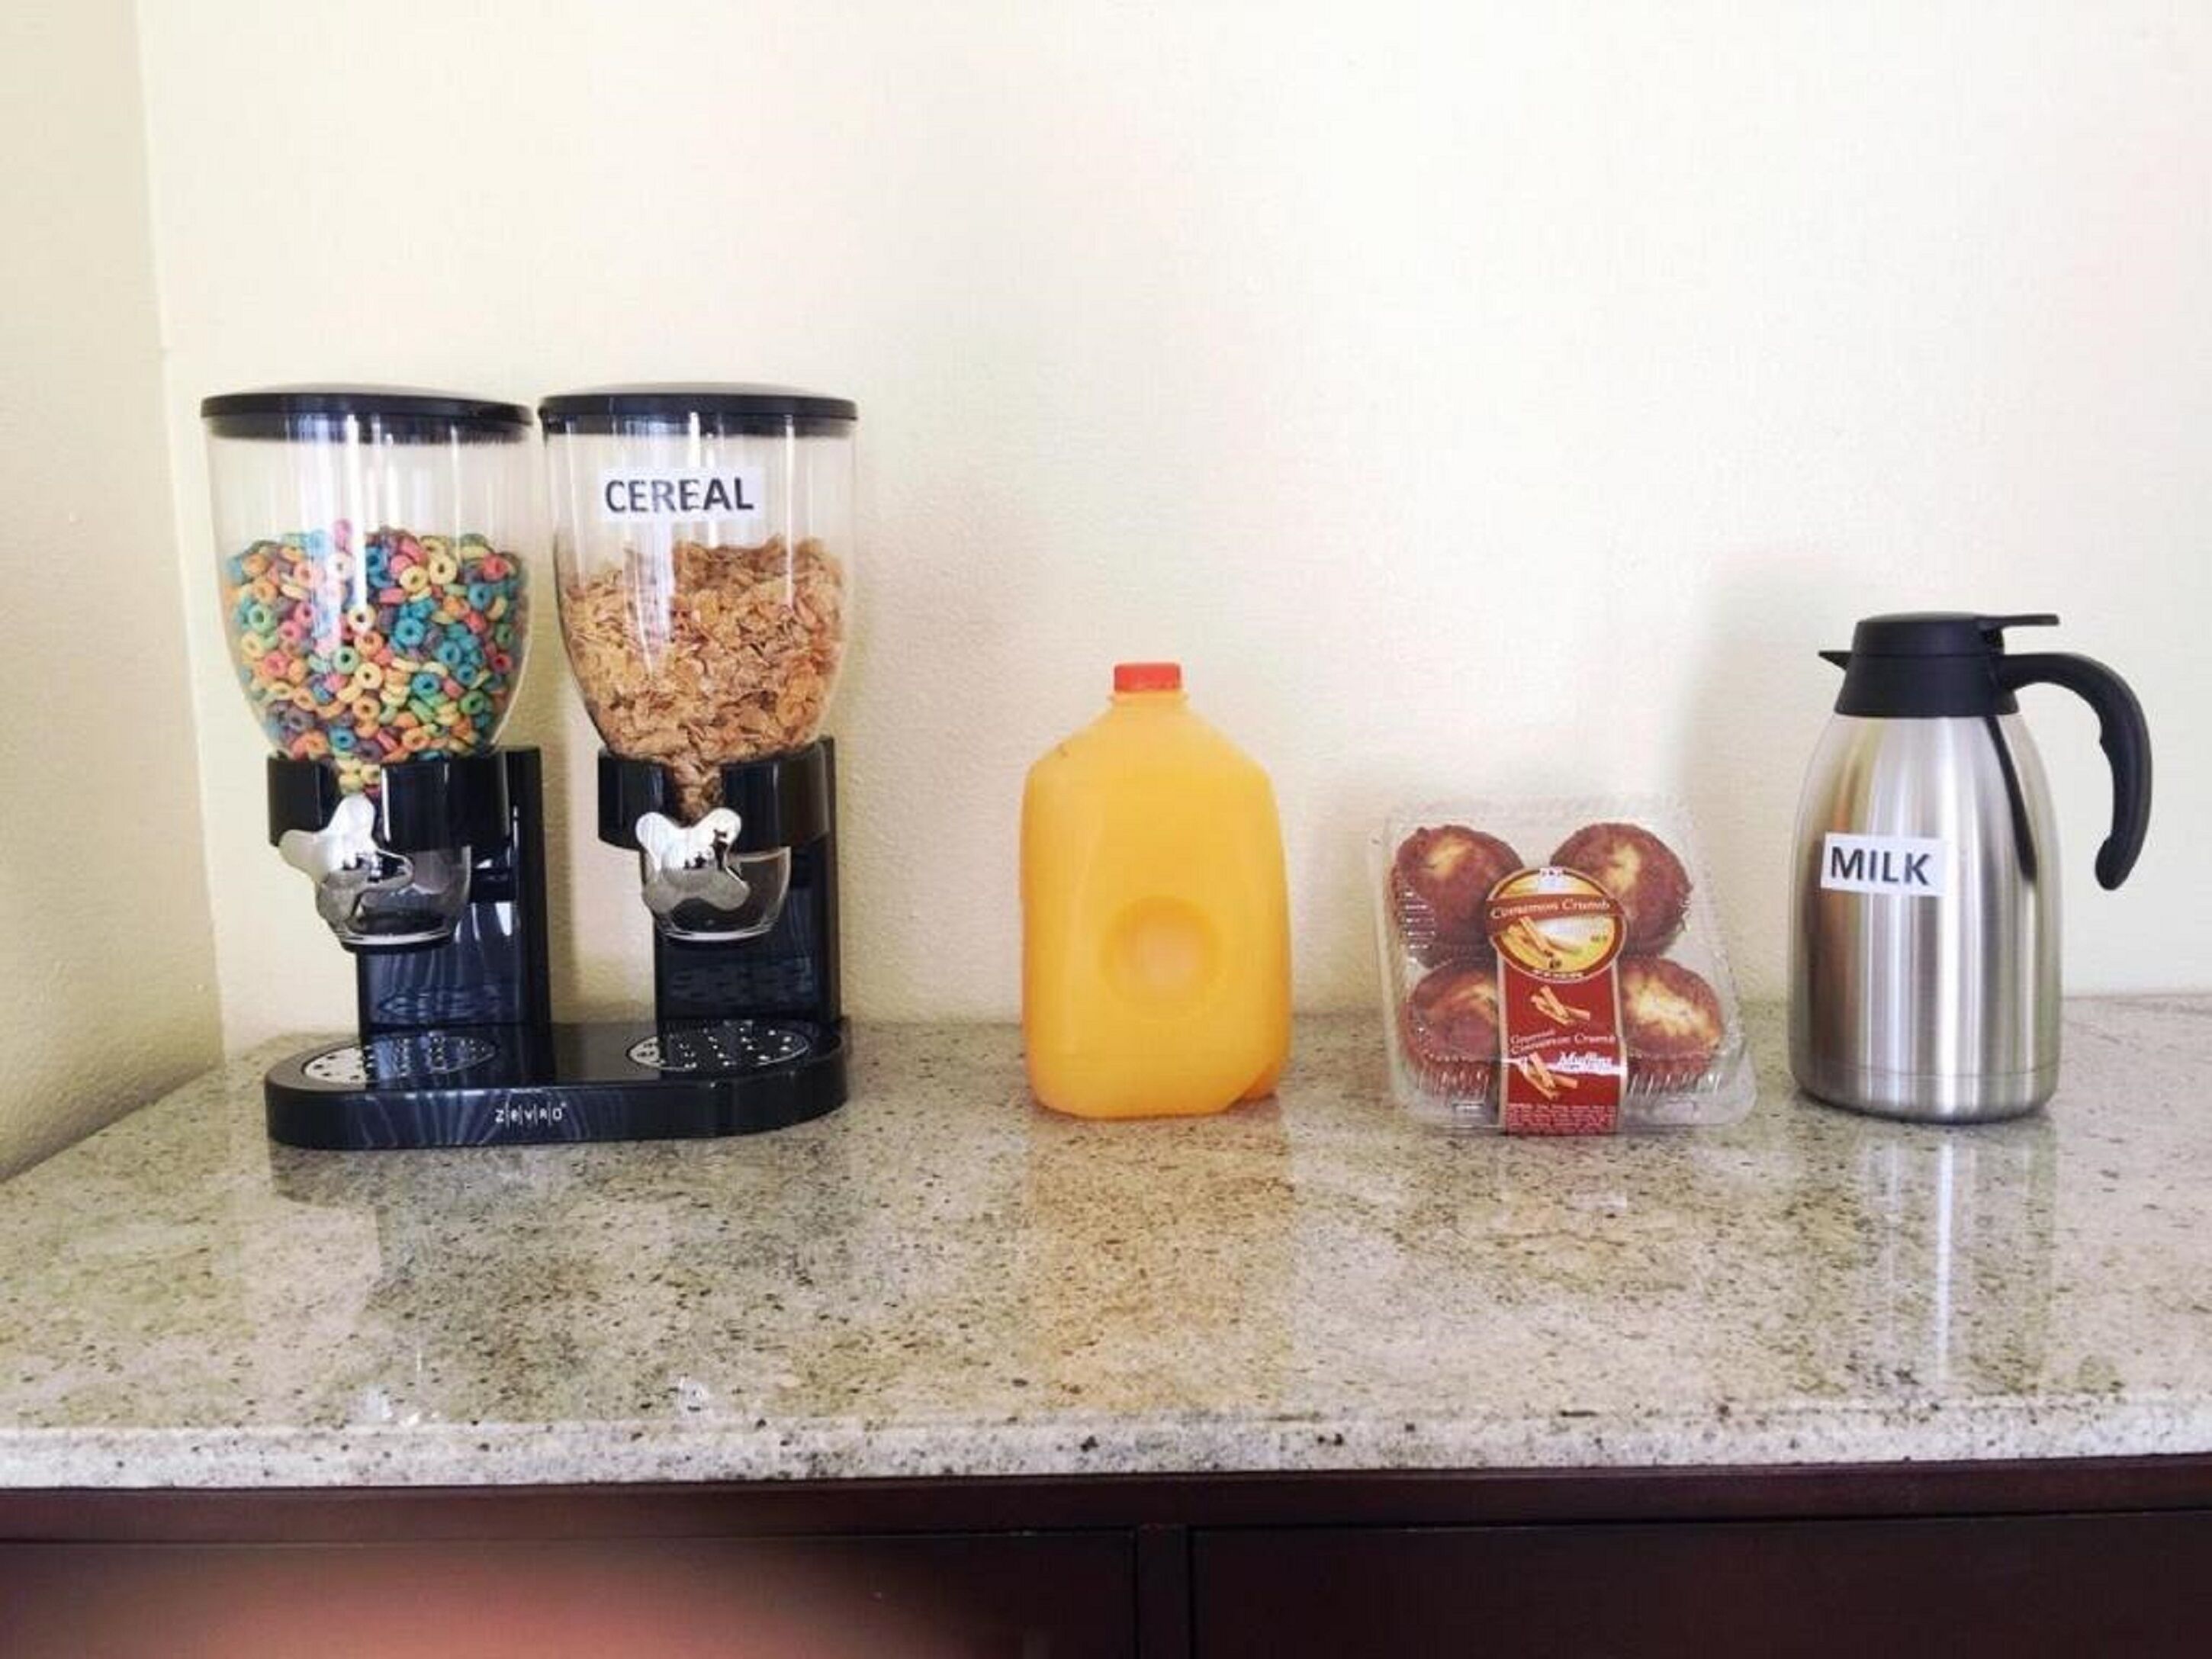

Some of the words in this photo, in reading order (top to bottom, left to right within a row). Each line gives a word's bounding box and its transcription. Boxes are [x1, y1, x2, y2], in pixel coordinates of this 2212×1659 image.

[605, 476, 754, 513] CEREAL
[1831, 846, 1931, 886] MILK
[1489, 903, 1558, 919] Cinnamon
[1561, 898, 1611, 911] Crumb
